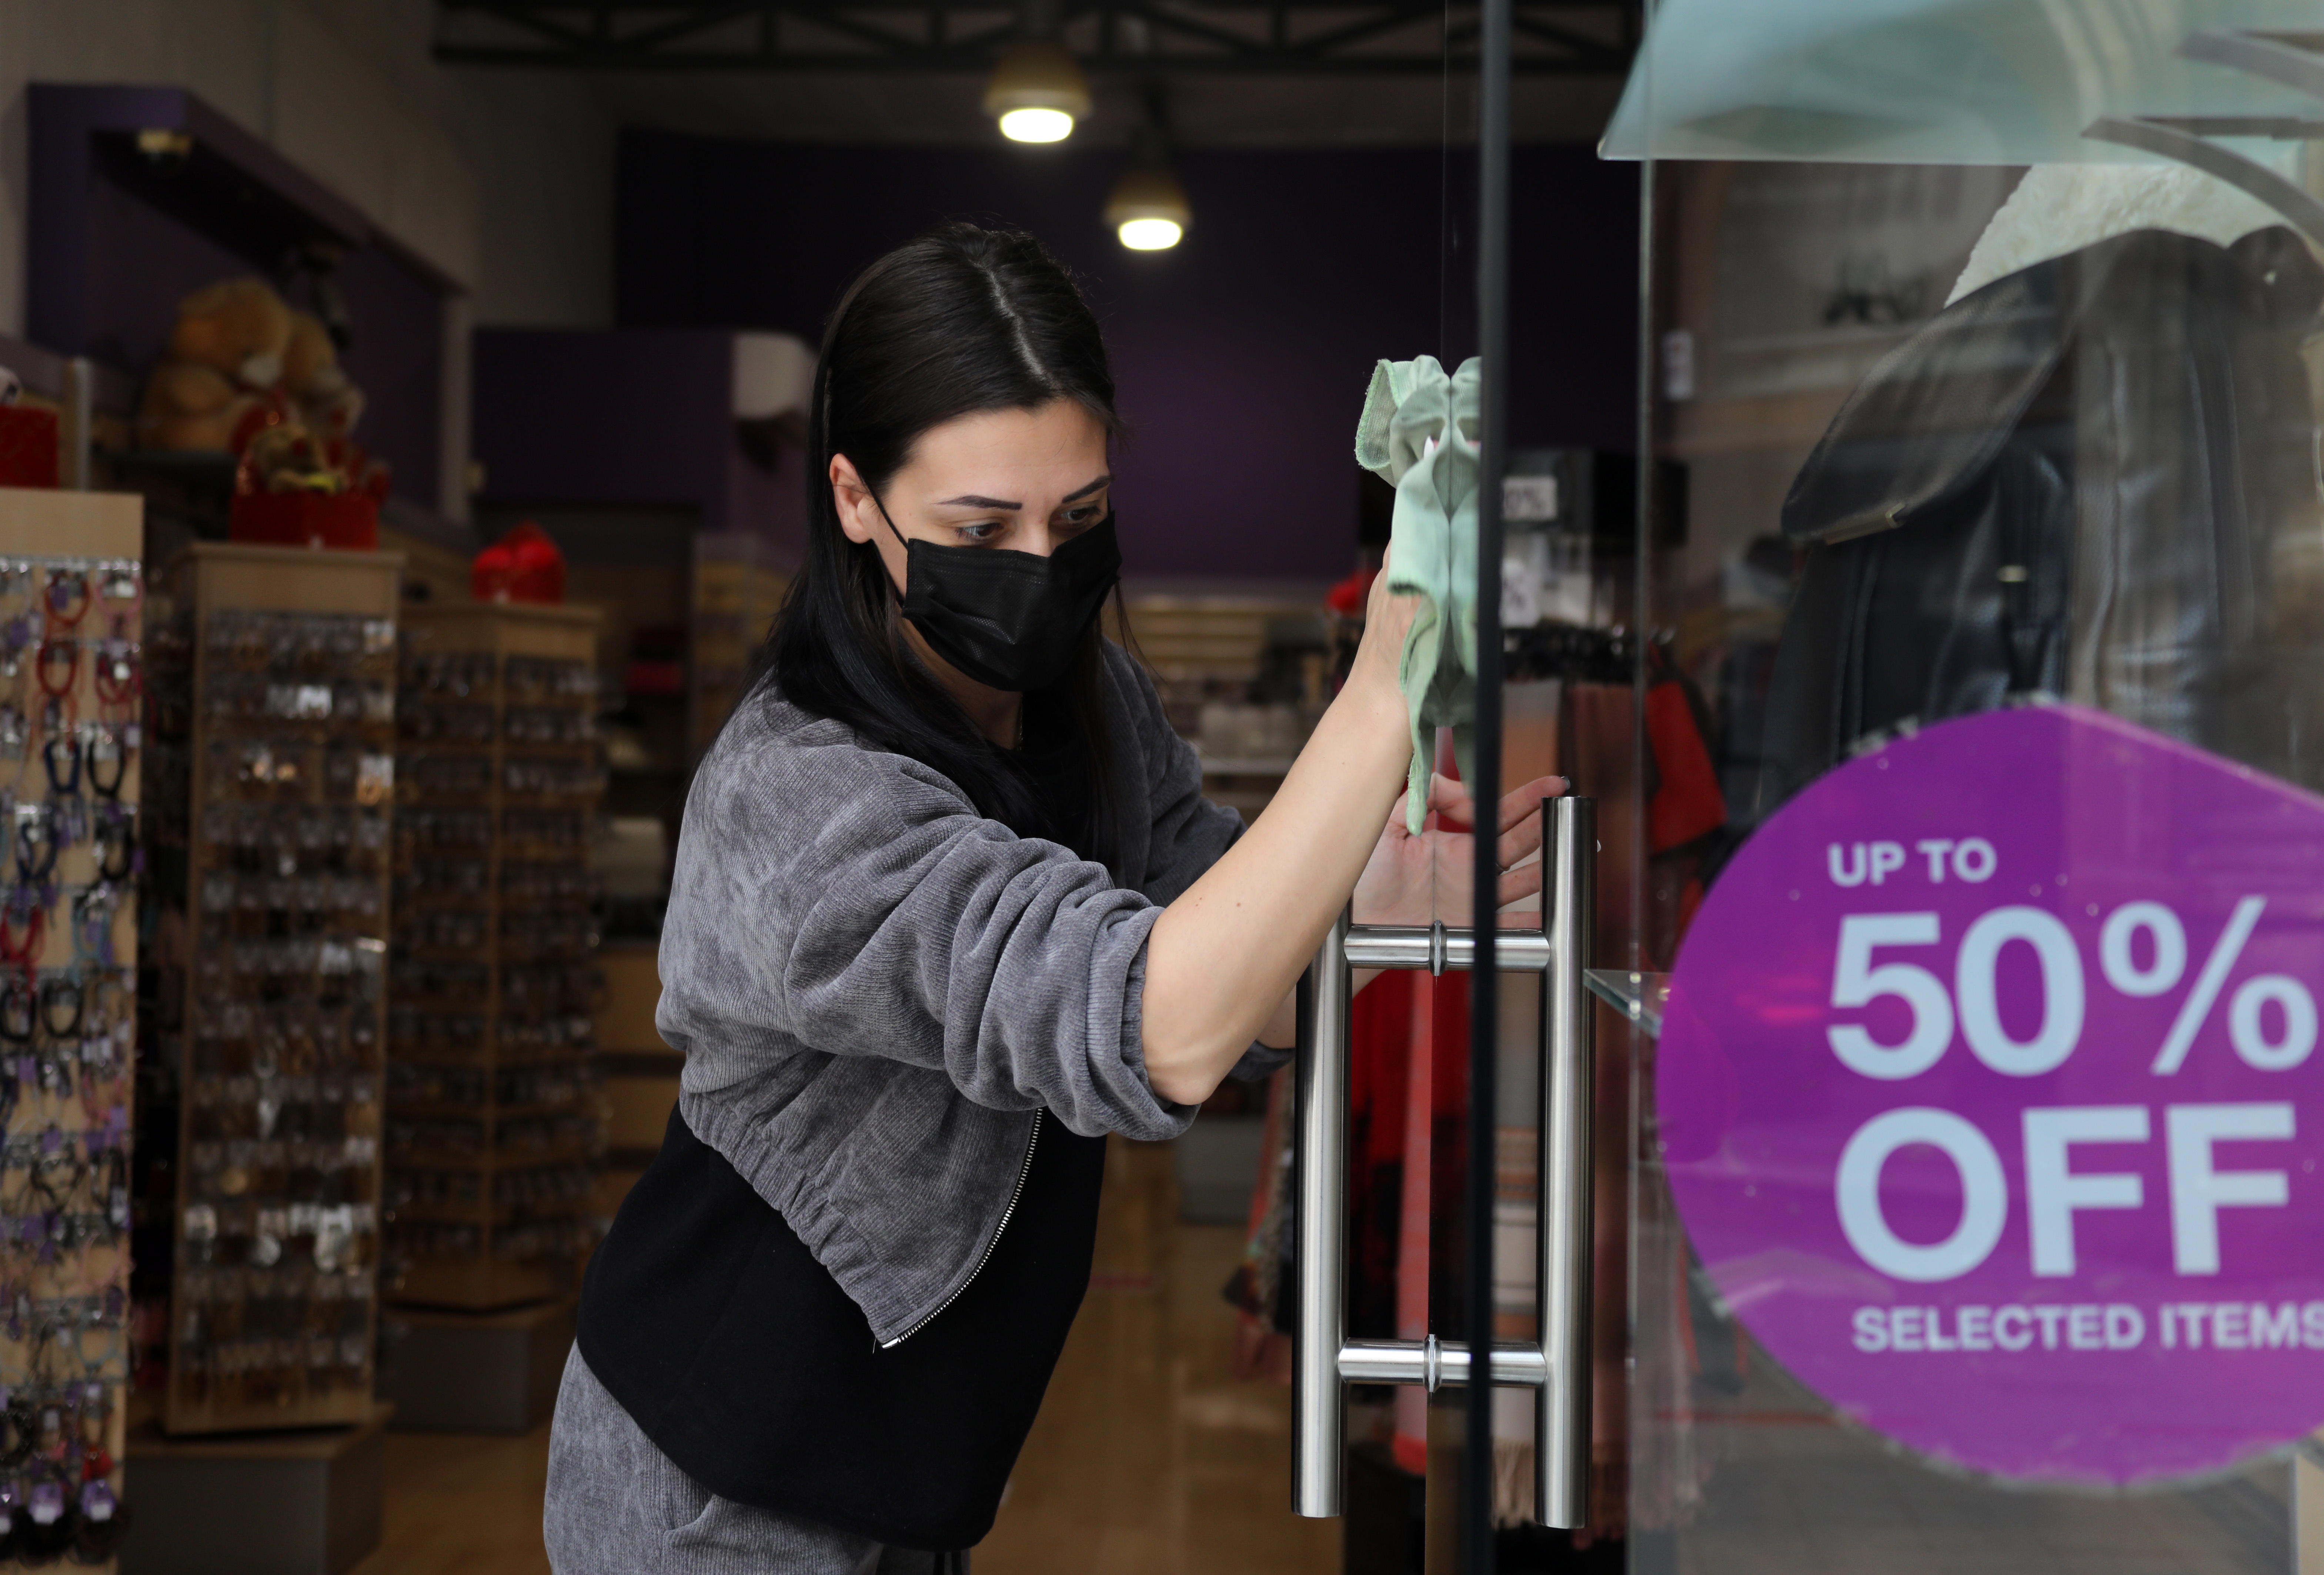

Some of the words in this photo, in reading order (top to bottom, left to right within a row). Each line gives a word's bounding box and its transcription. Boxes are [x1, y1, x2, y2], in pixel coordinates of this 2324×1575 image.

[1829, 843, 1904, 886] UP
[1919, 838, 1996, 882] TO
[1827, 896, 2318, 1080] 50%
[1835, 1102, 2296, 1282] OFF
[1853, 1304, 2146, 1352] SELECTED
[2159, 1300, 2324, 1349] ITEMS
